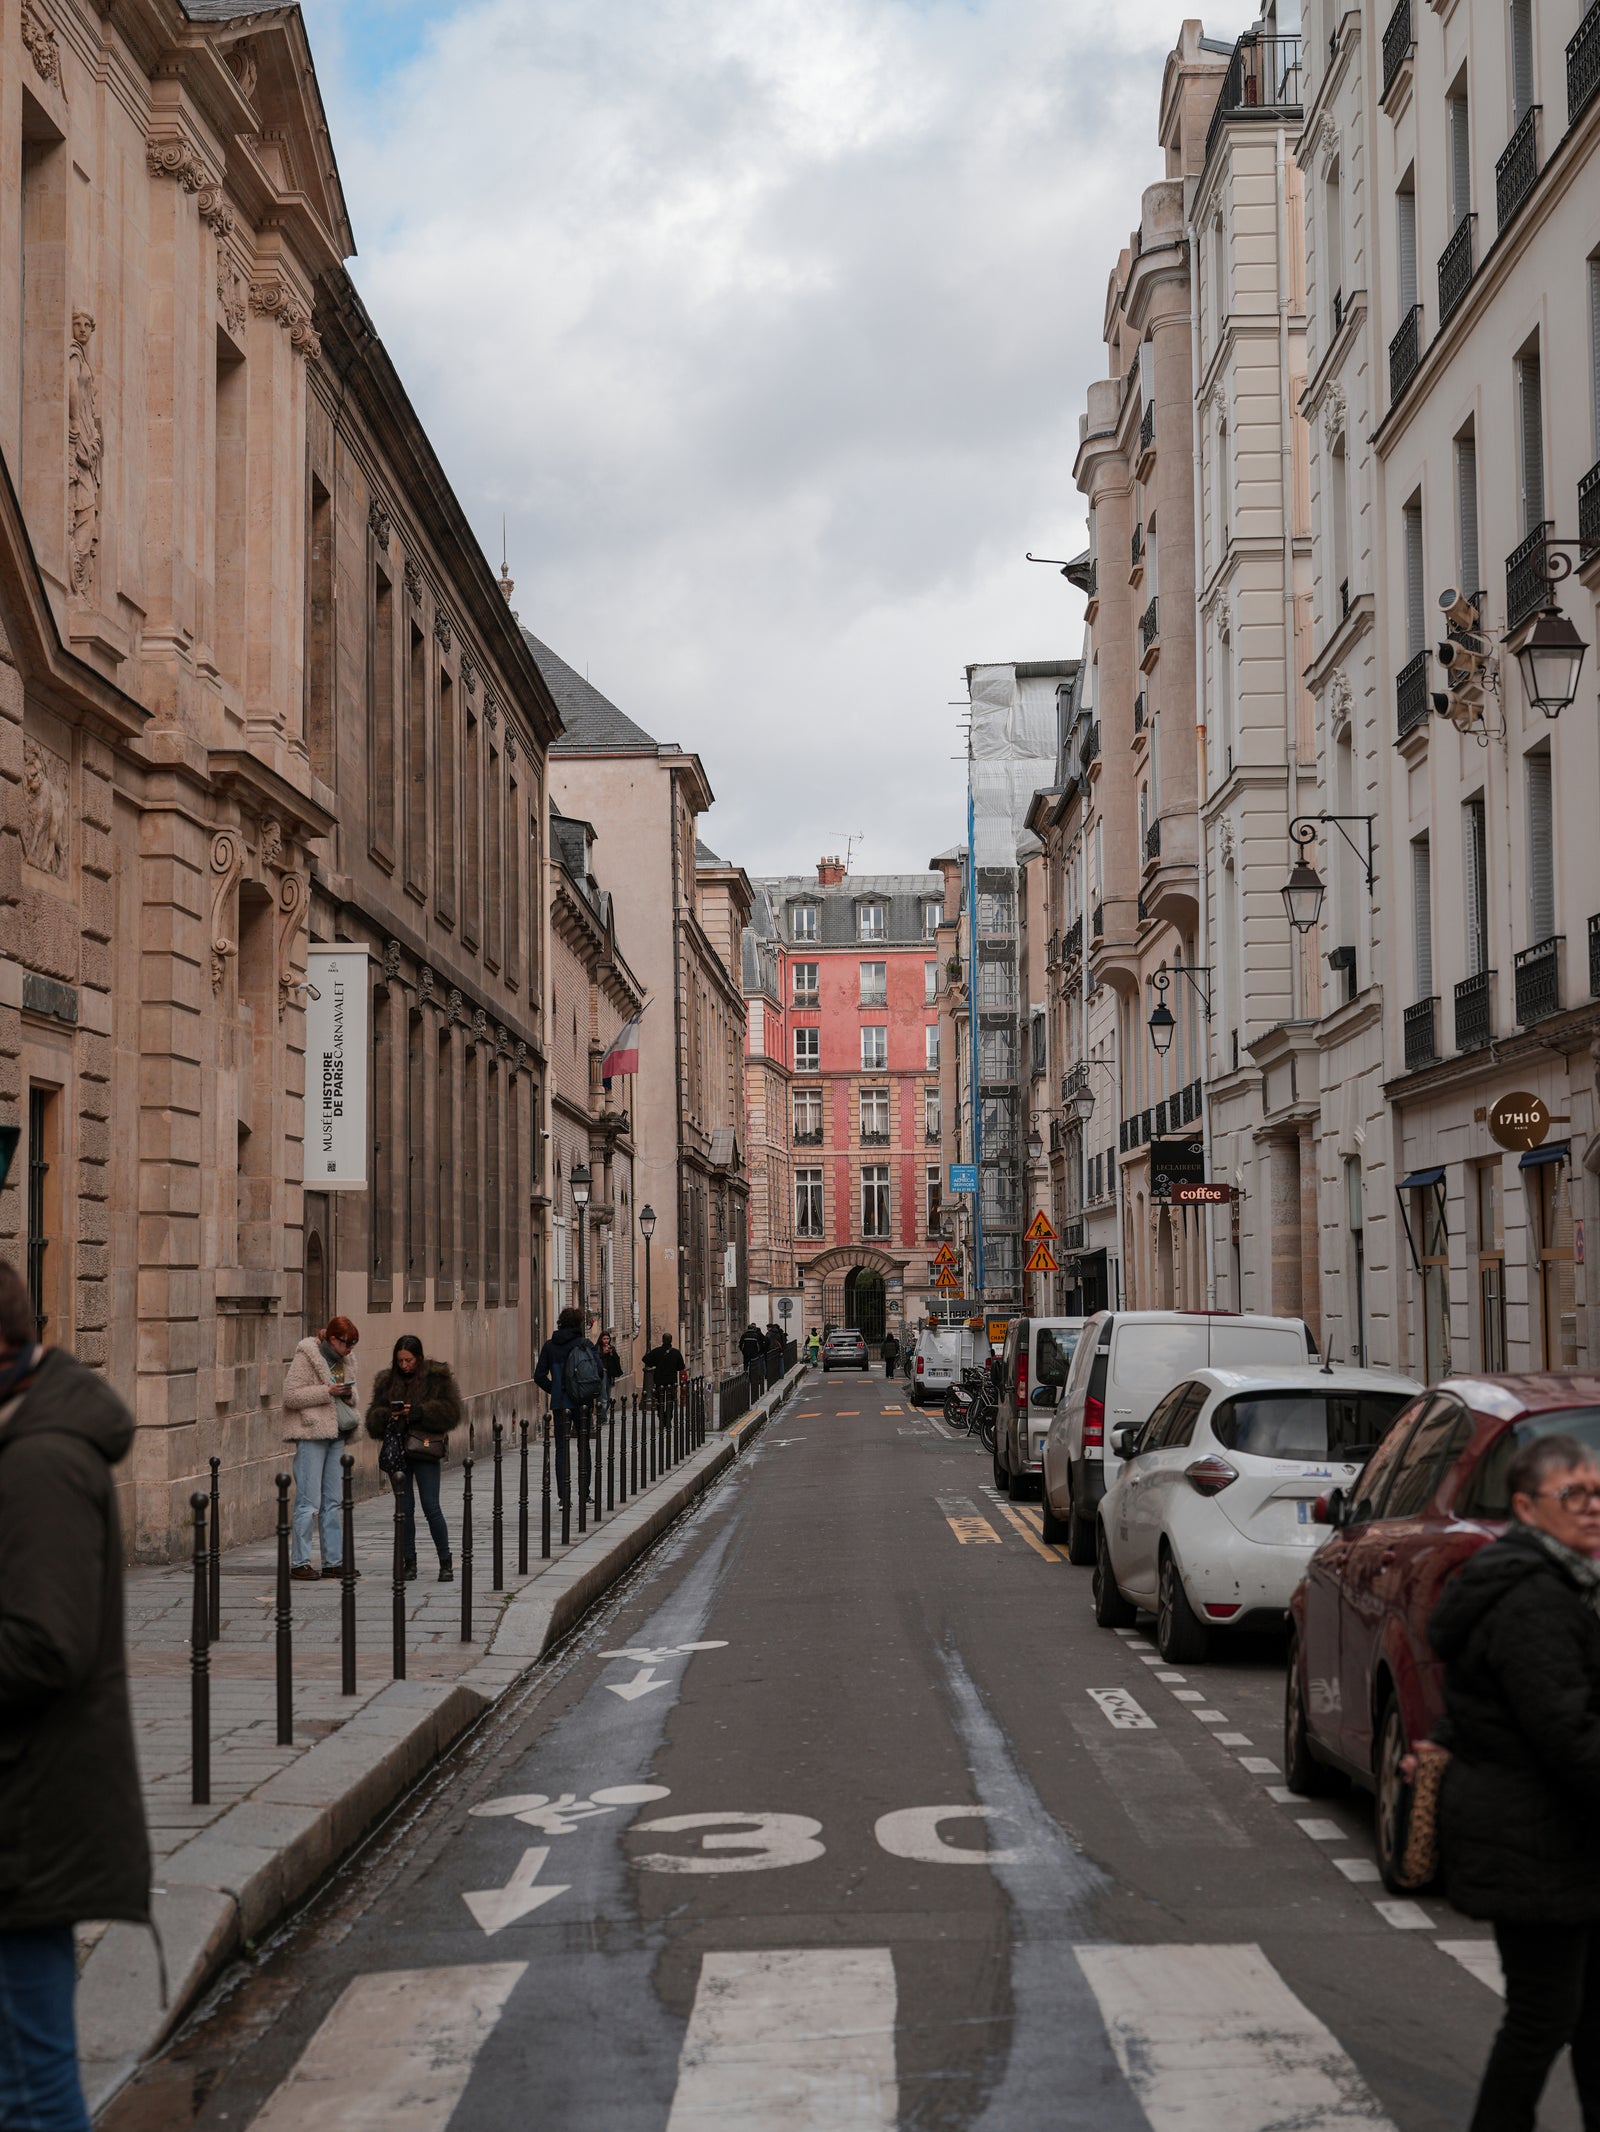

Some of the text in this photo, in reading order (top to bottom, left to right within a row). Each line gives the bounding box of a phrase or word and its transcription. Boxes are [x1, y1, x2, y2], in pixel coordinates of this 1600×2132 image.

[333, 981, 344, 1059] CARNAVALET
[321, 1052, 333, 1152] MUSÉE HISTOIRE
[333, 1100, 344, 1117] DE
[1499, 1111, 1541, 1125] 17H10
[1156, 1163, 1202, 1171] LECLAIREUR
[1180, 1187, 1222, 1200] coffee
